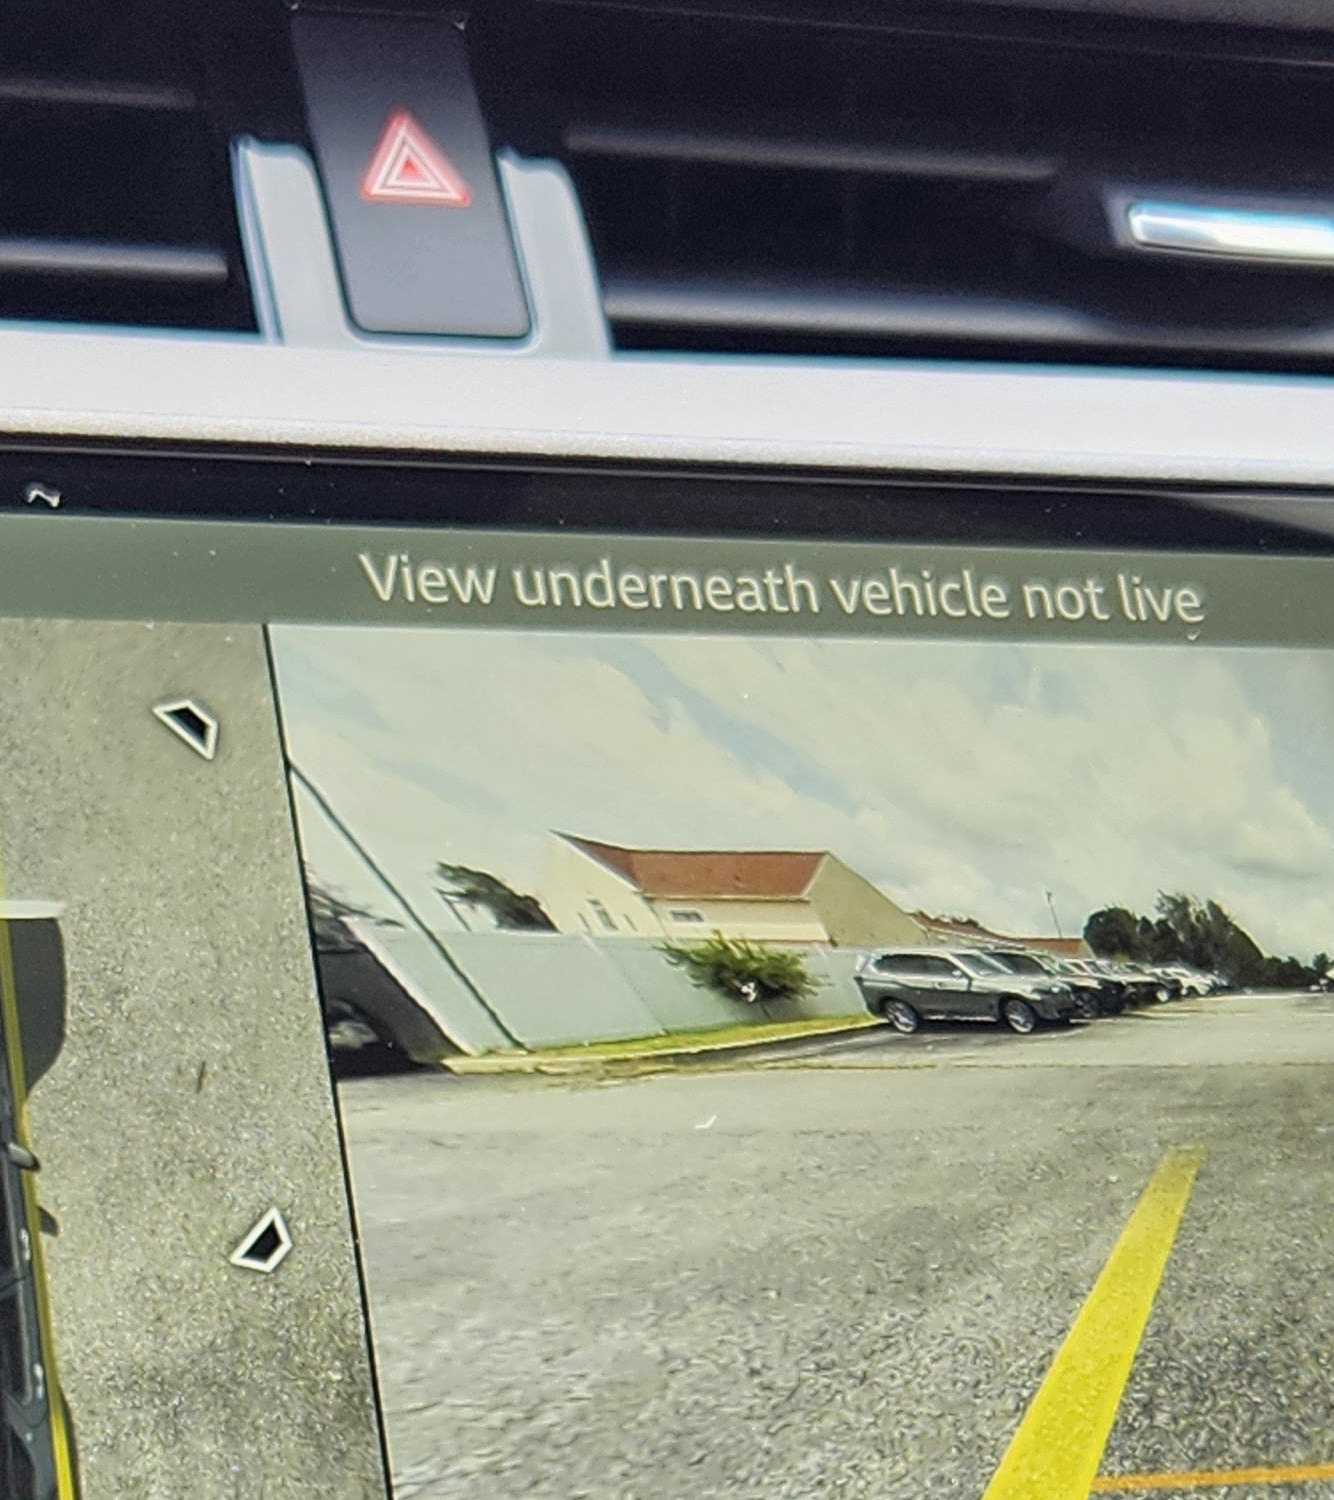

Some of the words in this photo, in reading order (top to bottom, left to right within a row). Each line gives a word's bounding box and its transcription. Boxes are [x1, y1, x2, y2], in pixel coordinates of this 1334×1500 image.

[359, 551, 496, 606] View
[511, 562, 820, 616] underneath
[829, 567, 1009, 620] vehicle
[1023, 575, 1108, 621] not
[1117, 573, 1204, 625] live
